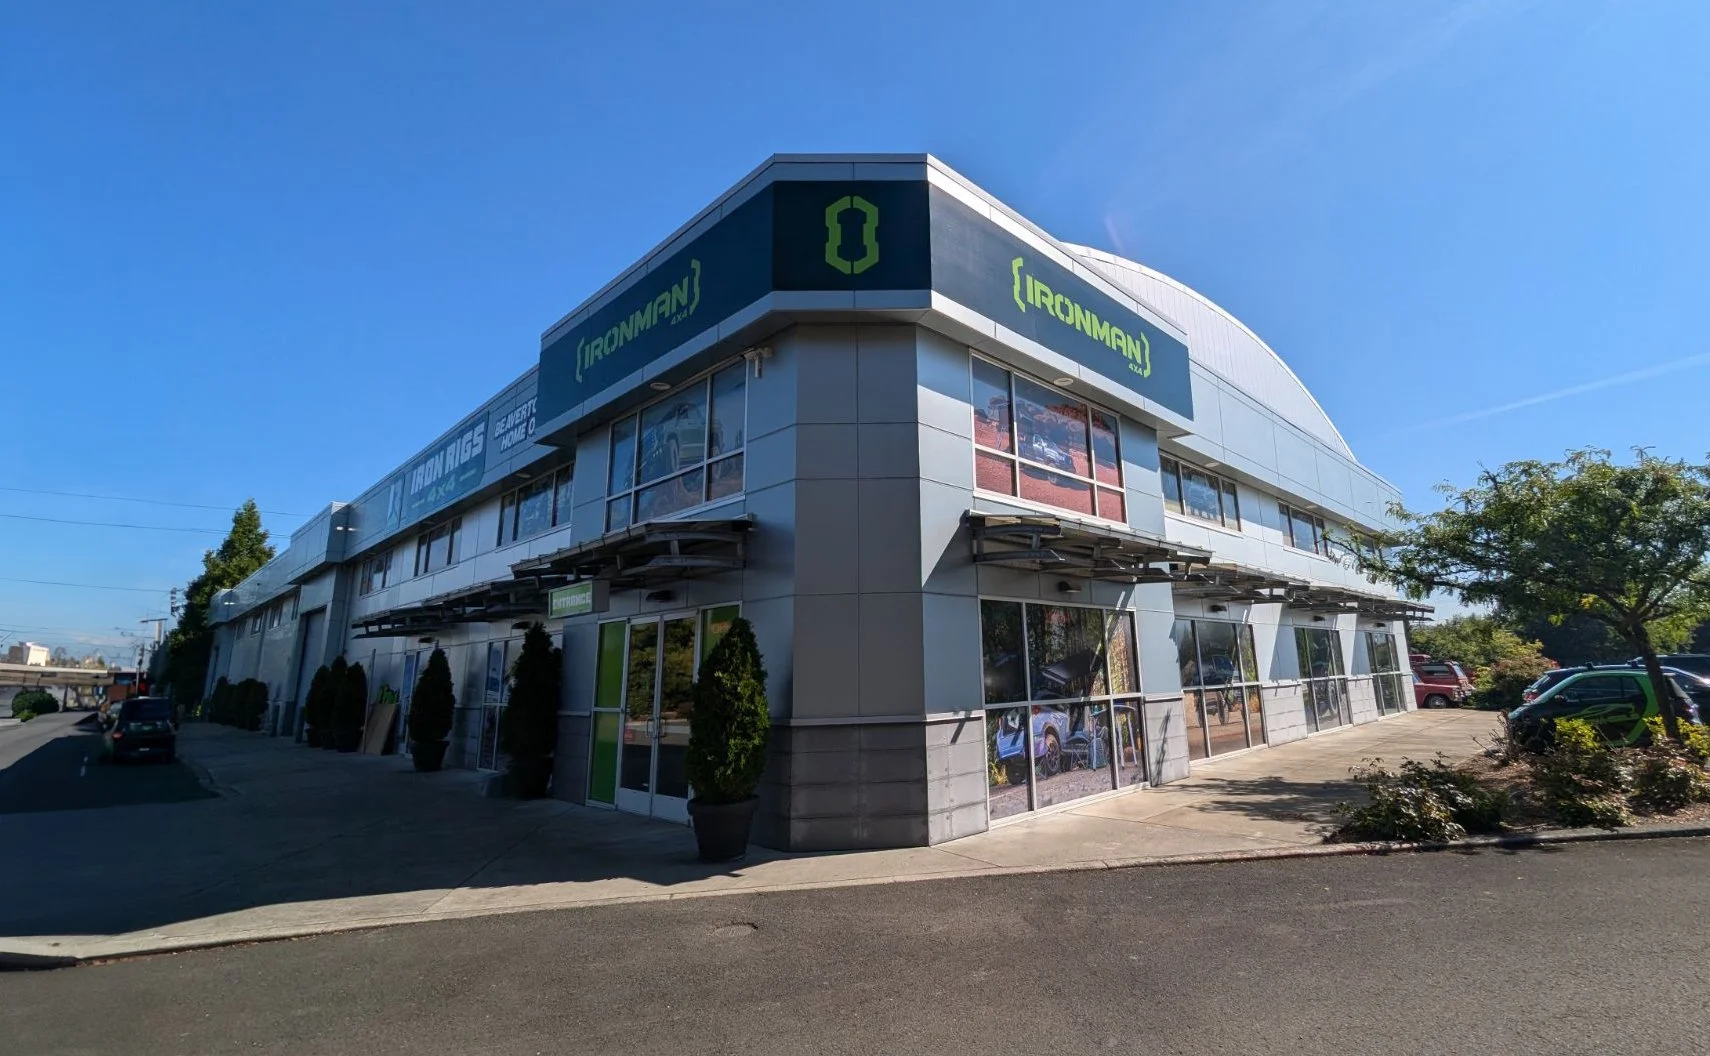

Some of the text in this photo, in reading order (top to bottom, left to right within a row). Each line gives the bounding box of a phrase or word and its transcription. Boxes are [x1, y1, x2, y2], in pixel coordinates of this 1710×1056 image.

[584, 276, 689, 370] IRONMAN
[1026, 274, 1142, 364] IRONMAN
[411, 422, 485, 495] IRON RIGS
[501, 422, 527, 451] HOME
